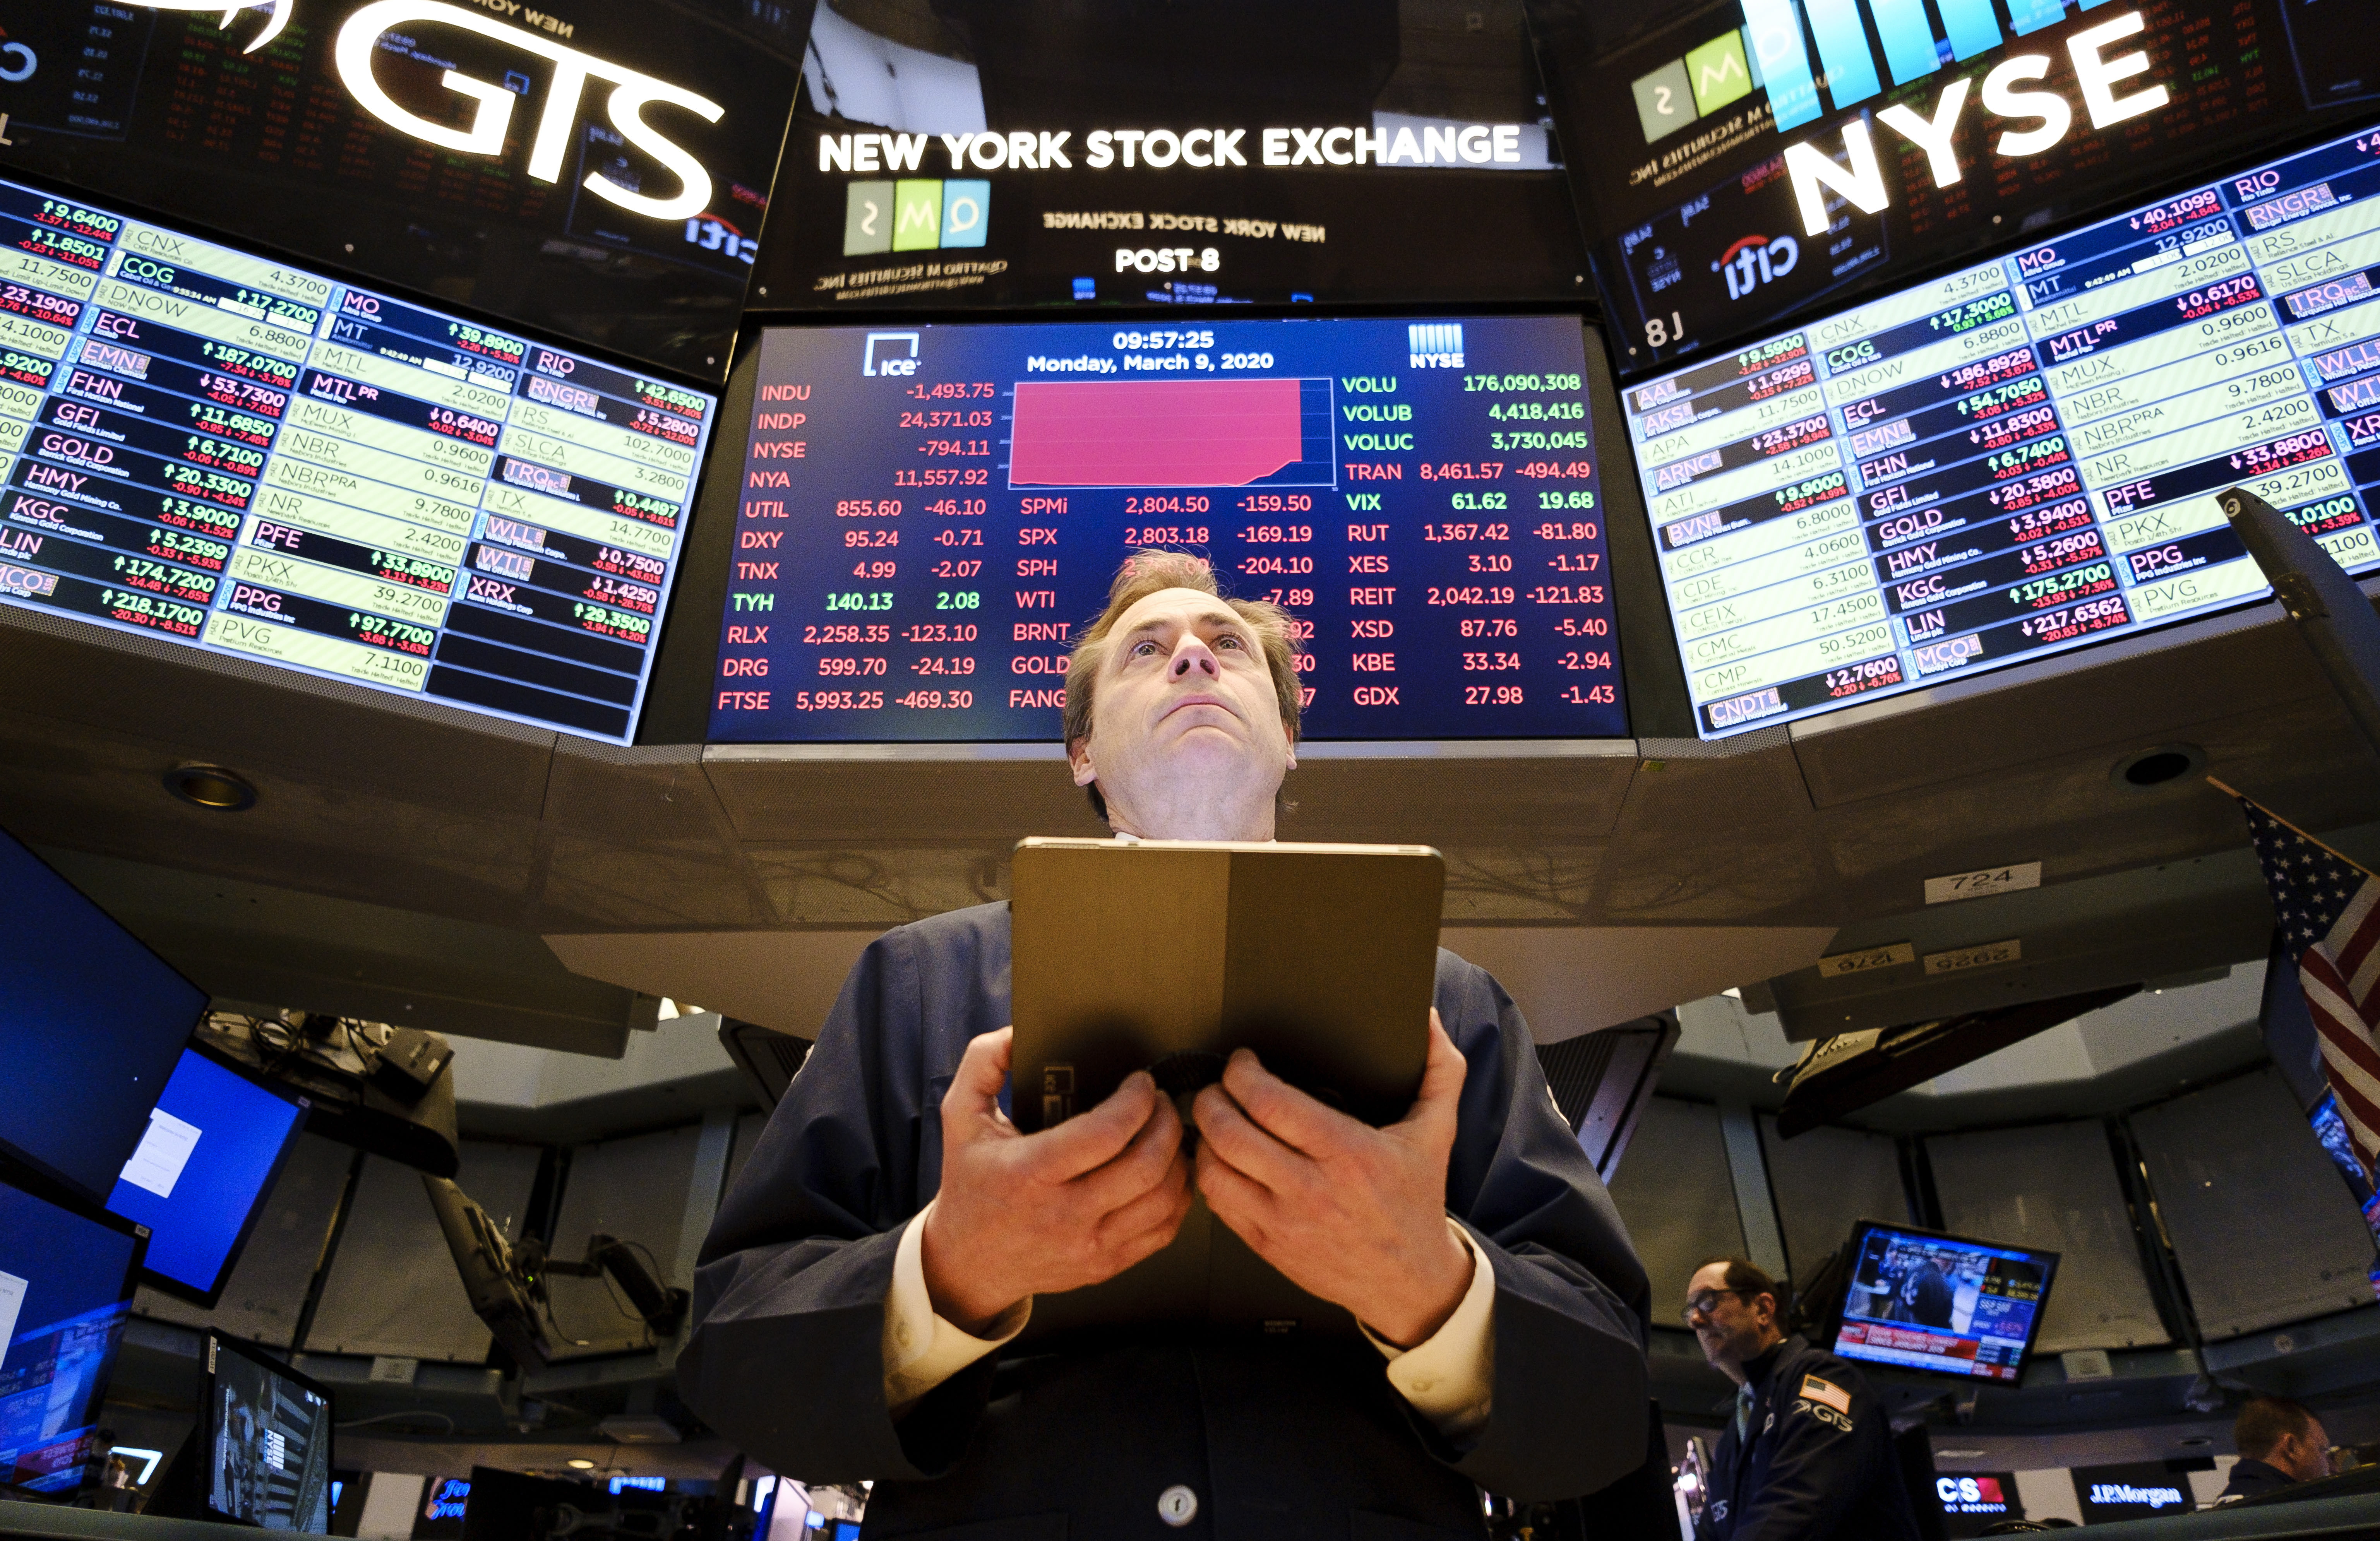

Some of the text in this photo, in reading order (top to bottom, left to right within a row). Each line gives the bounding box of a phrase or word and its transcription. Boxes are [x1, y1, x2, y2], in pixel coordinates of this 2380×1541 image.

[336, 0, 725, 220] GTS
[1784, 12, 2168, 236] NYSE
[818, 124, 1520, 172] NEW YORK STOCK EXCHANGE
[2235, 170, 2280, 197] RIO
[2143, 191, 2216, 224] 40.1099
[56, 205, 118, 233] 9.6400
[137, 231, 187, 256] CNX
[123, 257, 175, 284] COG
[1115, 248, 1220, 272] POST 8
[2018, 248, 2056, 272] MO
[2277, 251, 2342, 282] SLCA
[269, 271, 327, 295] 4.3700
[96, 312, 140, 339] ECL
[1645, 311, 1684, 348] 8J
[1113, 331, 1214, 349] 09:57:25
[538, 351, 575, 374] RIO
[1028, 353, 1273, 373] Monday, March 9, 2020
[1410, 353, 1465, 368] NYSE
[1828, 340, 1875, 368] COG
[69, 371, 123, 399] FHN
[762, 383, 994, 401] INDU -1,493.75
[1342, 375, 1581, 392] VOLU 176,090,308
[758, 411, 992, 429] INDP 24,371.03
[1343, 402, 1585, 421] VOLUB 4,418,416
[1843, 399, 1886, 424] ECL
[43, 434, 114, 464] GOLD
[623, 435, 692, 464] 102.7000
[754, 440, 990, 458] NYSE -794.11
[1344, 432, 1587, 451] VOLUC 3,730,045
[27, 465, 88, 492] HMY
[750, 469, 988, 488] NYA 11,557.92
[1345, 462, 1590, 481] TRAN 8,461.57 -494.49
[1021, 495, 1311, 515] SPMi 2,804.50 -159.50
[1346, 493, 1594, 510] VIX 61.62 19.68
[2106, 480, 2155, 509] PFE
[13, 496, 69, 524] KGC
[746, 499, 986, 518] UTIL 855.60 -46.10
[1348, 523, 1597, 543] RUT 1,367.42 -81.80
[1879, 509, 1943, 540] GOLD
[257, 522, 303, 549] PFE
[741, 529, 984, 548] DXY 95.24 -0.71
[1019, 526, 1312, 545] SPX 2,803.18 -169.19
[738, 560, 982, 579] TNX 4.99 -2.07
[1017, 556, 1313, 576] SPH -204.10
[1348, 555, 1599, 573] XES 3.10 -1.17
[126, 559, 216, 592] 174.7200
[2024, 564, 2111, 601] 175.2700
[233, 585, 282, 611] PPG
[468, 576, 516, 603] XRX
[1016, 591, 1055, 608] WTI
[1350, 586, 1604, 606] REIT 2,042.19 -121.83
[1897, 575, 1946, 603] KGC
[113, 592, 203, 625] 218.1700
[733, 592, 979, 611] TYH 140.13 2.08
[2034, 597, 2124, 634] 217.6362
[728, 625, 977, 645] RLX 2,258.35 -123.10
[1014, 623, 1071, 640] BRNT
[1351, 620, 1607, 638] XSD 87.76 -5.40
[723, 657, 975, 676] DRG 599.70 -24.19
[1011, 656, 1071, 675] GOLD
[1353, 652, 1611, 671] KBE 33.34 -2.94
[718, 691, 972, 711] FTSE 5,993.25 -469.30
[1010, 689, 1067, 708] FANG
[1354, 685, 1615, 705] GDX 27.98 -1.43
[1949, 869, 2012, 890] 724
